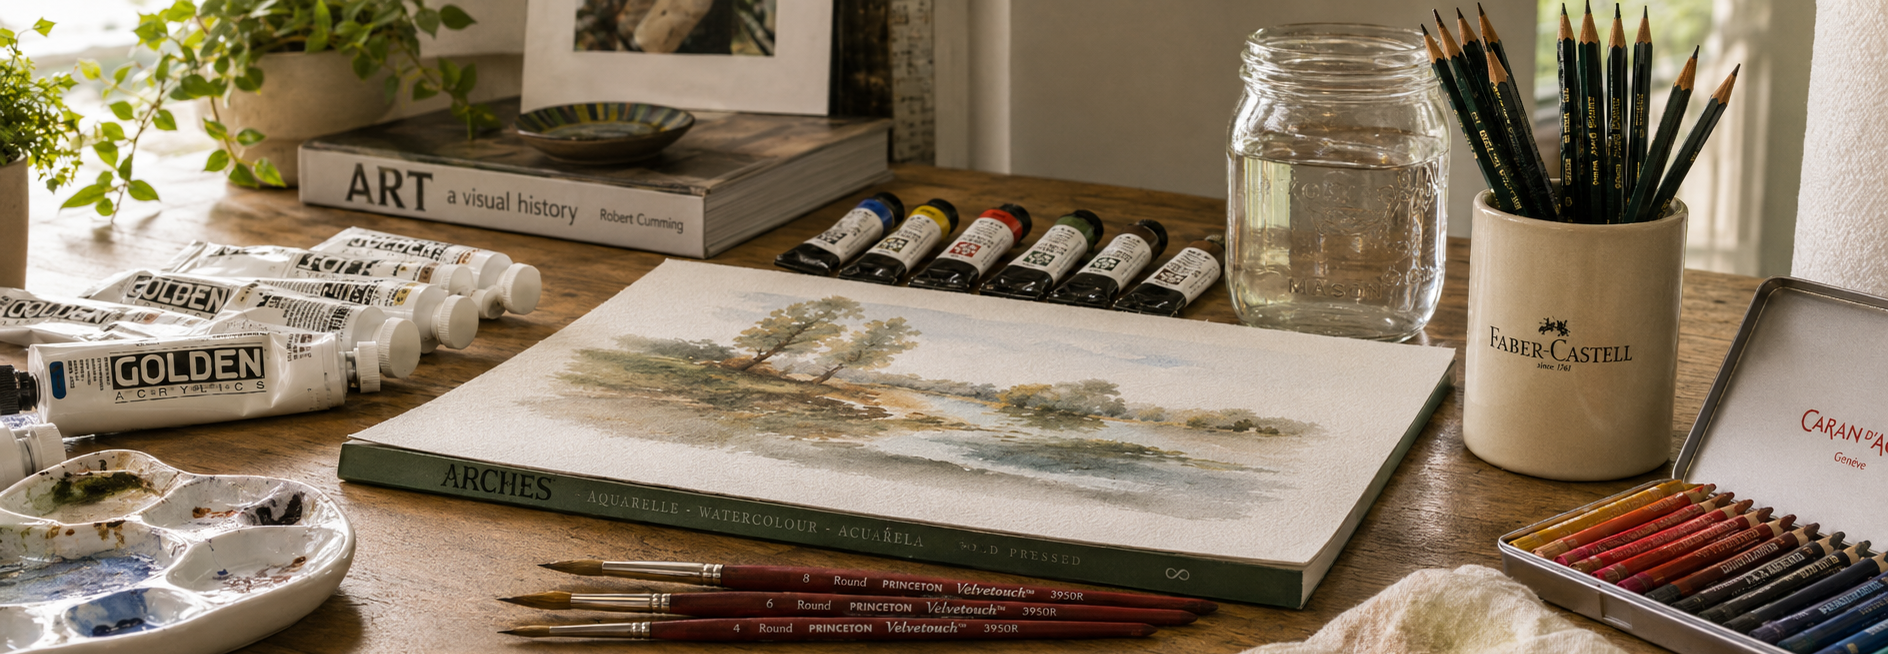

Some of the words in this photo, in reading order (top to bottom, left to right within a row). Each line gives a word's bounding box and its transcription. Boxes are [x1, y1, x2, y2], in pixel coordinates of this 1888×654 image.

[345, 161, 433, 212] ART
[446, 189, 457, 205] a
[463, 187, 510, 212] visual
[518, 192, 579, 225] history
[600, 208, 634, 225] Robert
[637, 213, 684, 234] Cumming
[1490, 325, 1633, 364] FABER-CASTELL
[114, 347, 263, 387] GOLDEN
[1537, 362, 1554, 371] since
[1556, 363, 1572, 372] 1761
[1801, 408, 1864, 444] CARAN
[1864, 429, 1888, 457] D'A
[440, 463, 553, 501] ARCHES
[587, 490, 680, 515] AQUARELLE
[698, 504, 818, 534] WATERCOLOUR
[1009, 547, 1081, 566] PRESSED
[802, 573, 810, 584] 8
[833, 575, 868, 588] Round
[882, 579, 943, 593] PRINCETON
[766, 598, 774, 609] 6
[797, 599, 832, 611] Round
[849, 601, 912, 613] PRINCETON
[733, 623, 741, 633] 4
[758, 622, 793, 633] Round
[808, 623, 873, 633] PRINCETON
